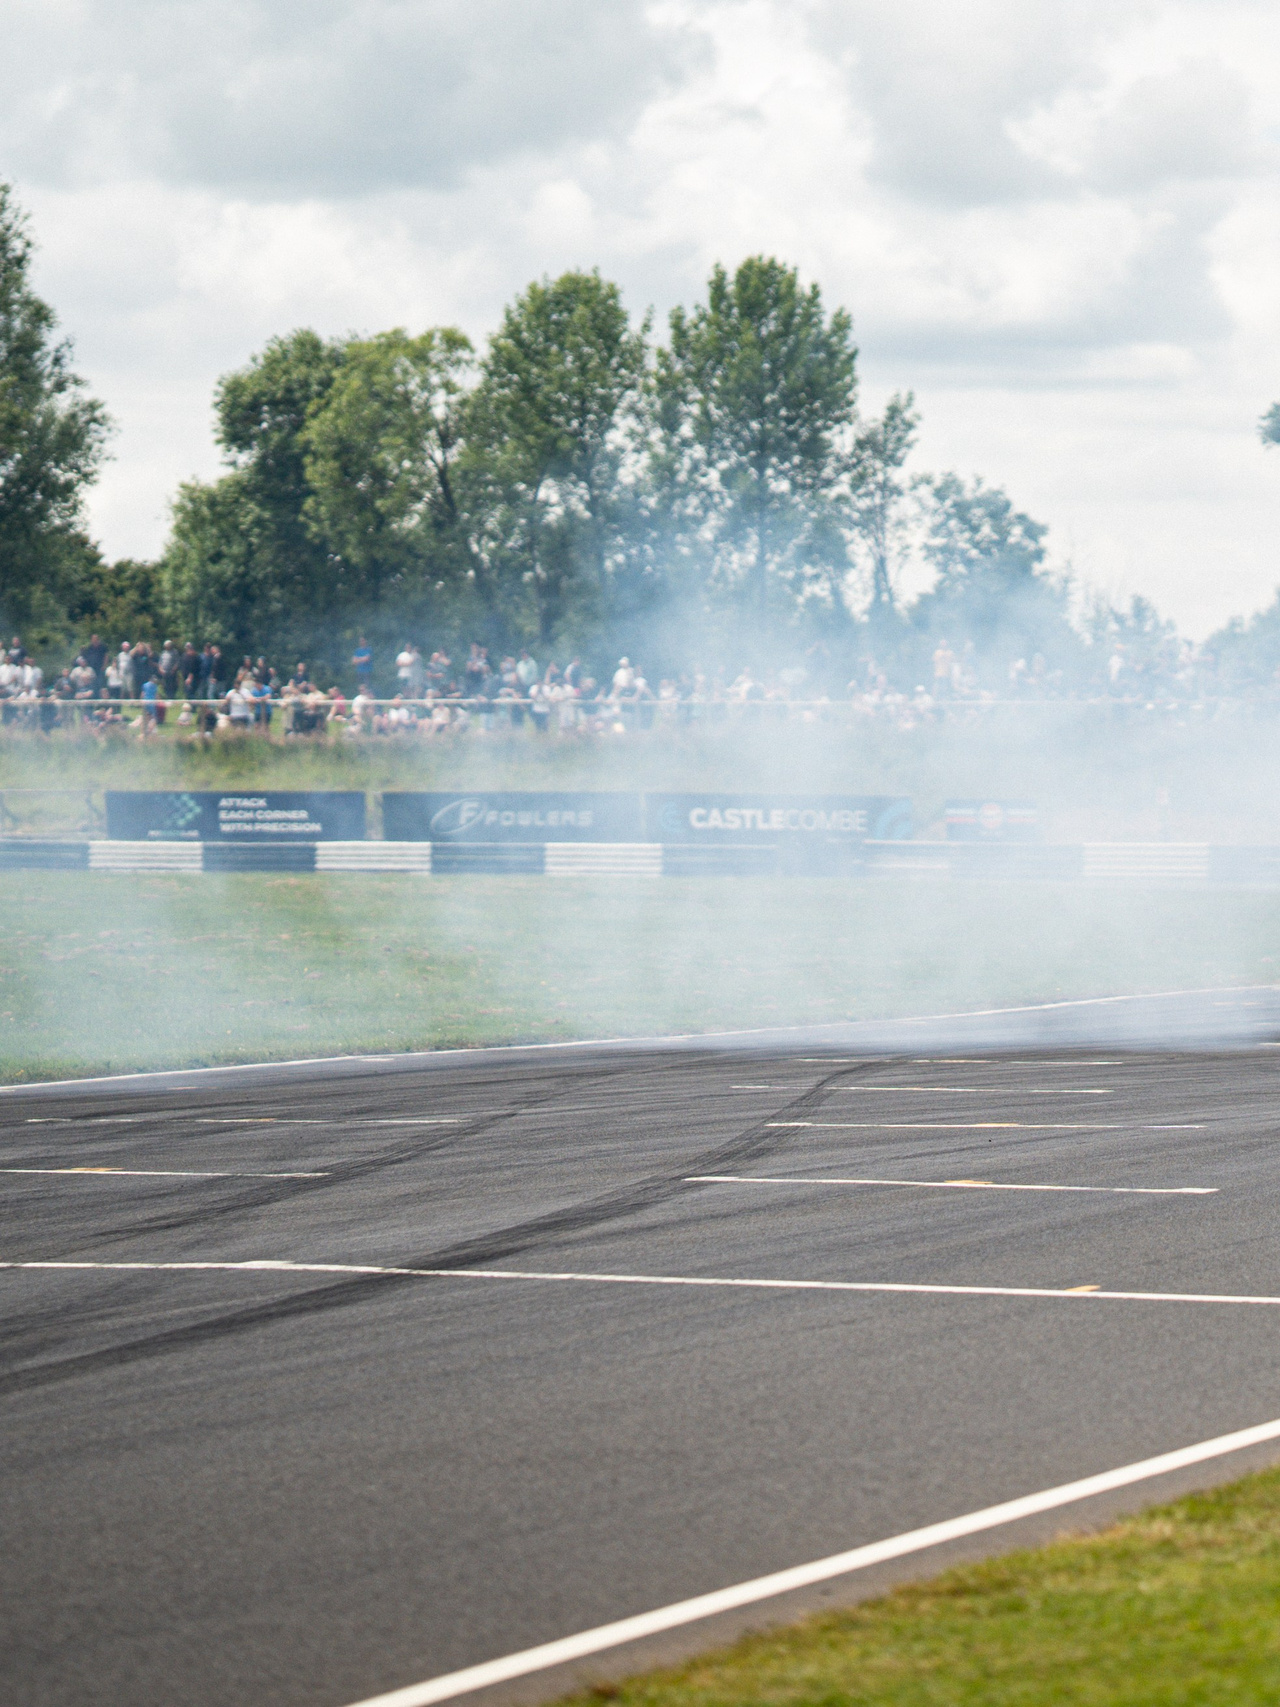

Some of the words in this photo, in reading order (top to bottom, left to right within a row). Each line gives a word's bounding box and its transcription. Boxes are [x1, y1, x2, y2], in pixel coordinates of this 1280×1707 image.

[219, 798, 267, 807] ATTACK
[219, 809, 254, 819] EACH
[255, 809, 309, 819] CORNER
[485, 810, 593, 827] FOWLERS
[219, 822, 253, 832] WITH
[254, 822, 322, 832] PRECISION
